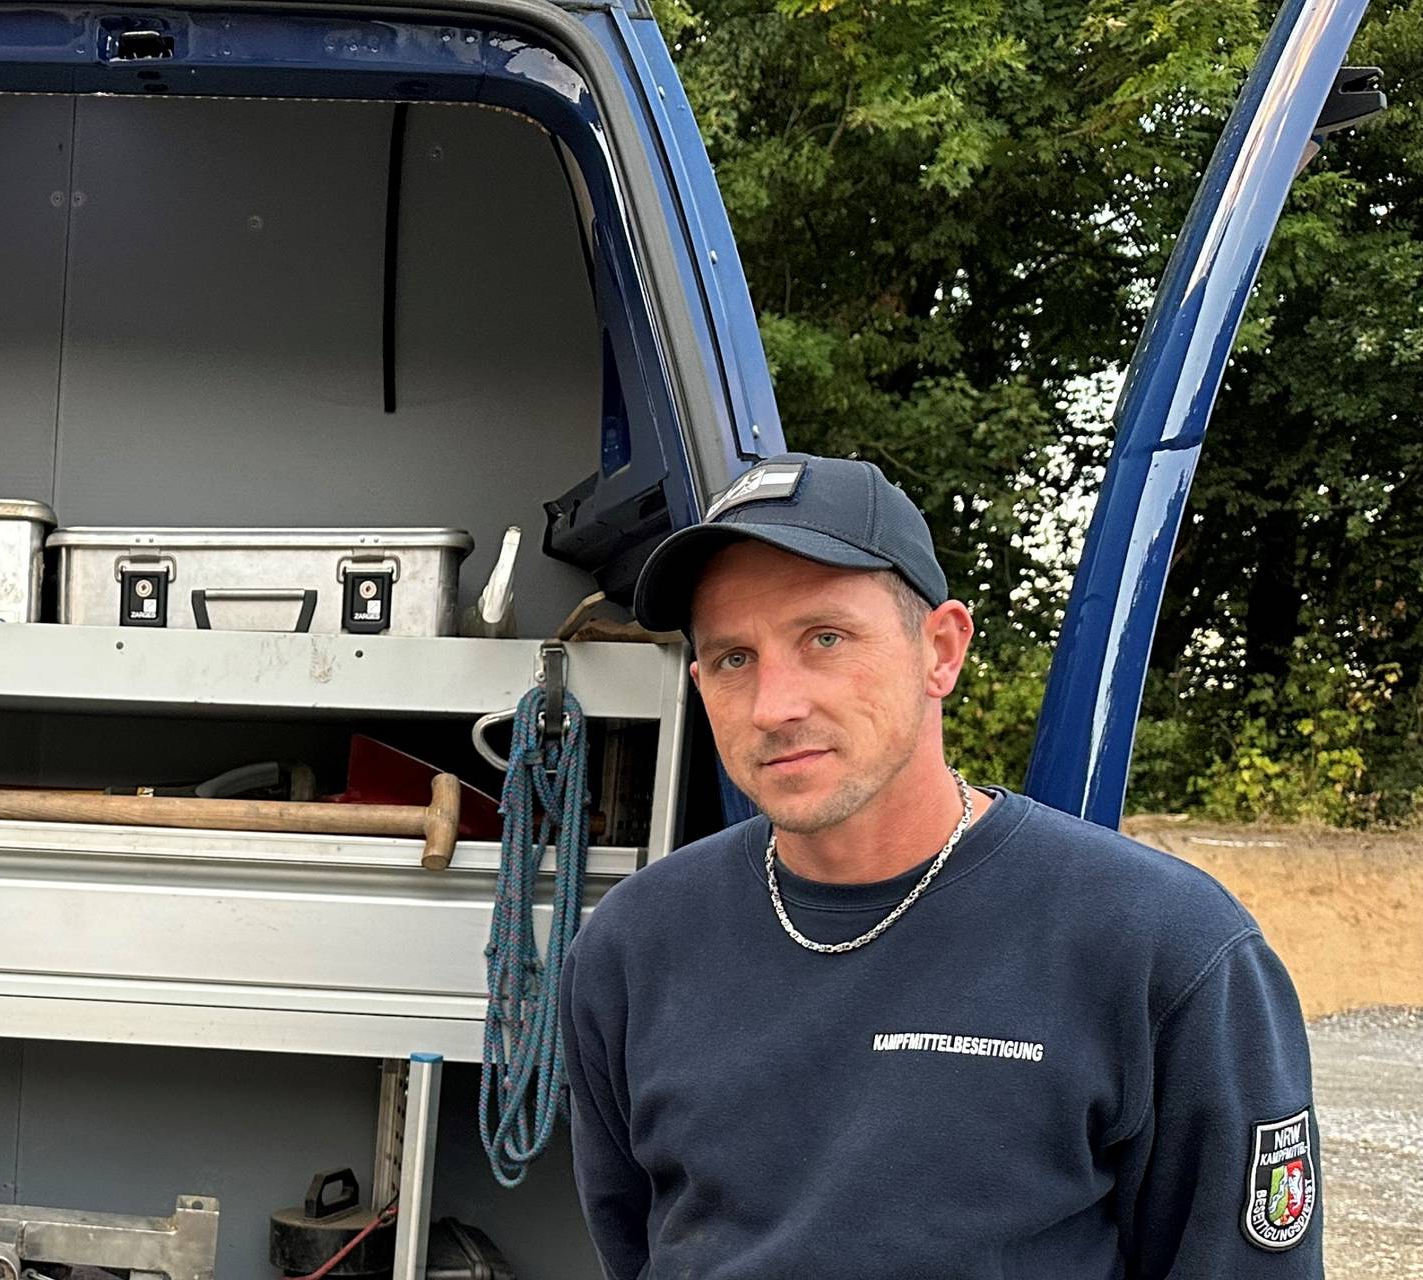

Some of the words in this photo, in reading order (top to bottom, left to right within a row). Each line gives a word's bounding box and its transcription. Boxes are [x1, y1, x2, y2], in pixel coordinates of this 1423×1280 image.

[873, 1033, 1044, 1062] KAMPFMITTELBESEITIGUNG
[1274, 1123, 1302, 1150] NRW
[1252, 1178, 1313, 1241] BESEITIGUNGSDIENST
